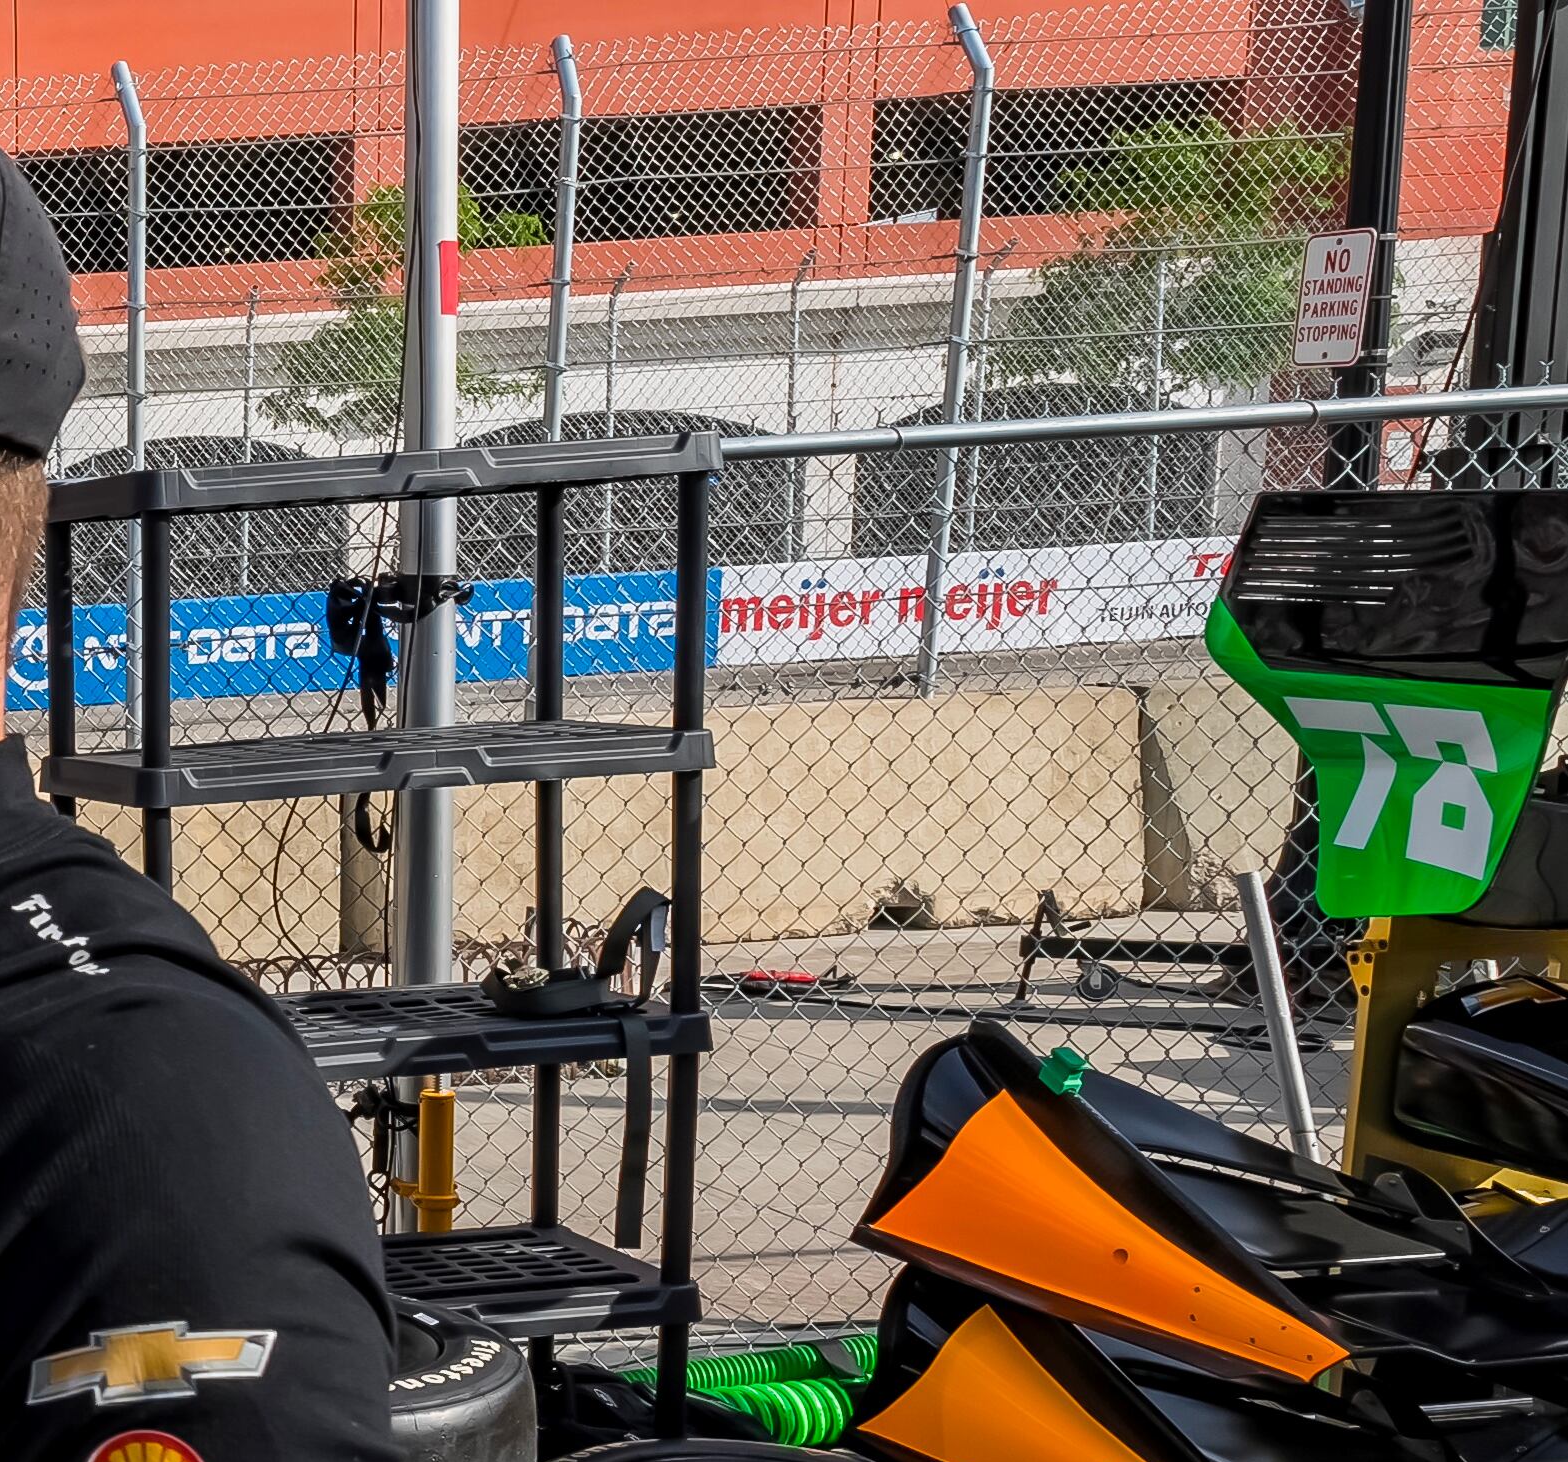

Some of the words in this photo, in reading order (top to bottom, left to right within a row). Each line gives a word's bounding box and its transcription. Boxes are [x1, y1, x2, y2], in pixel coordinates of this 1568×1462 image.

[1324, 249, 1351, 274] NO
[1303, 276, 1364, 296] STANDING
[1302, 300, 1358, 319] PARKING
[1298, 324, 1358, 342] STOPPING
[721, 578, 882, 641] meijer
[1159, 601, 1213, 619] AUTO
[1283, 696, 1498, 881] 78
